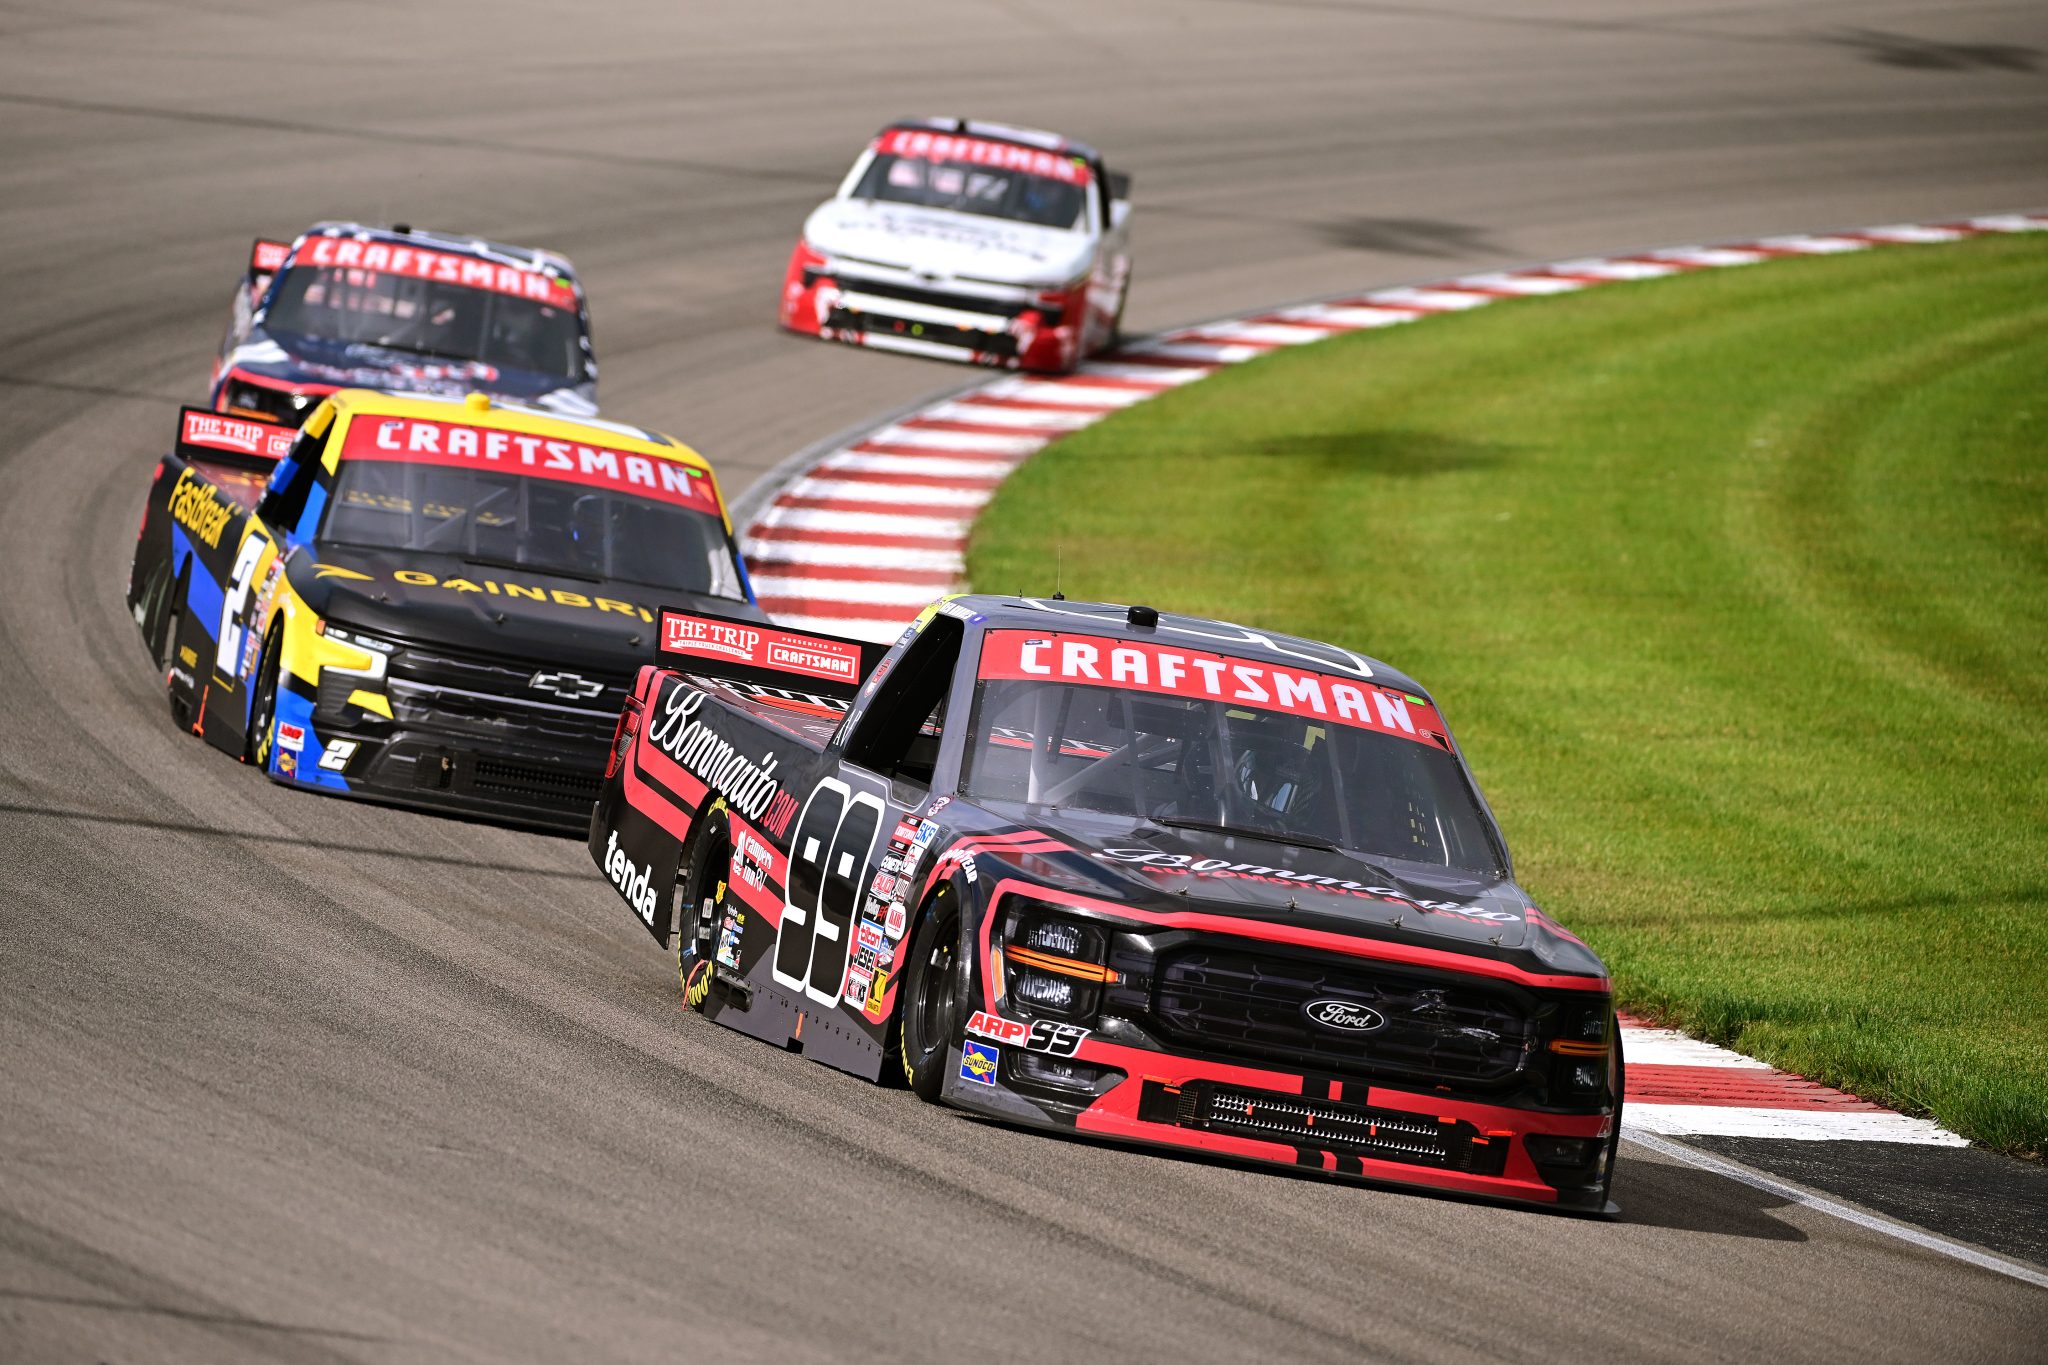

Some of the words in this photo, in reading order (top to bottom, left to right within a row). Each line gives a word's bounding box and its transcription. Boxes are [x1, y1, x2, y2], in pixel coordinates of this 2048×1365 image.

[892, 131, 1076, 179] CRAFTSMAN
[312, 237, 550, 297] CRAFTSMAN
[188, 415, 221, 434] THE
[223, 420, 264, 444] TRIP
[376, 422, 693, 496] CRAFTSMAN
[168, 466, 236, 550] FastBreak
[215, 530, 268, 680] 2
[393, 570, 659, 623] GAINBRI
[666, 617, 707, 640] THE
[711, 624, 760, 651] TRIP
[679, 640, 697, 648] TRIPLE
[782, 637, 829, 650] PRESENTED
[773, 648, 849, 673] CRAFTSMAN
[1020, 639, 1416, 734] CRAFTSMAN
[318, 738, 359, 771] 2
[915, 822, 937, 844] SKF
[745, 835, 772, 870] campers
[604, 830, 658, 926] tenda
[772, 776, 885, 1010] 99
[853, 945, 875, 973] JESEL
[1319, 1003, 1372, 1028] Ford
[966, 1012, 1024, 1042] ARP
[1024, 1019, 1092, 1058] 99
[963, 1056, 994, 1072] SUNOCO
